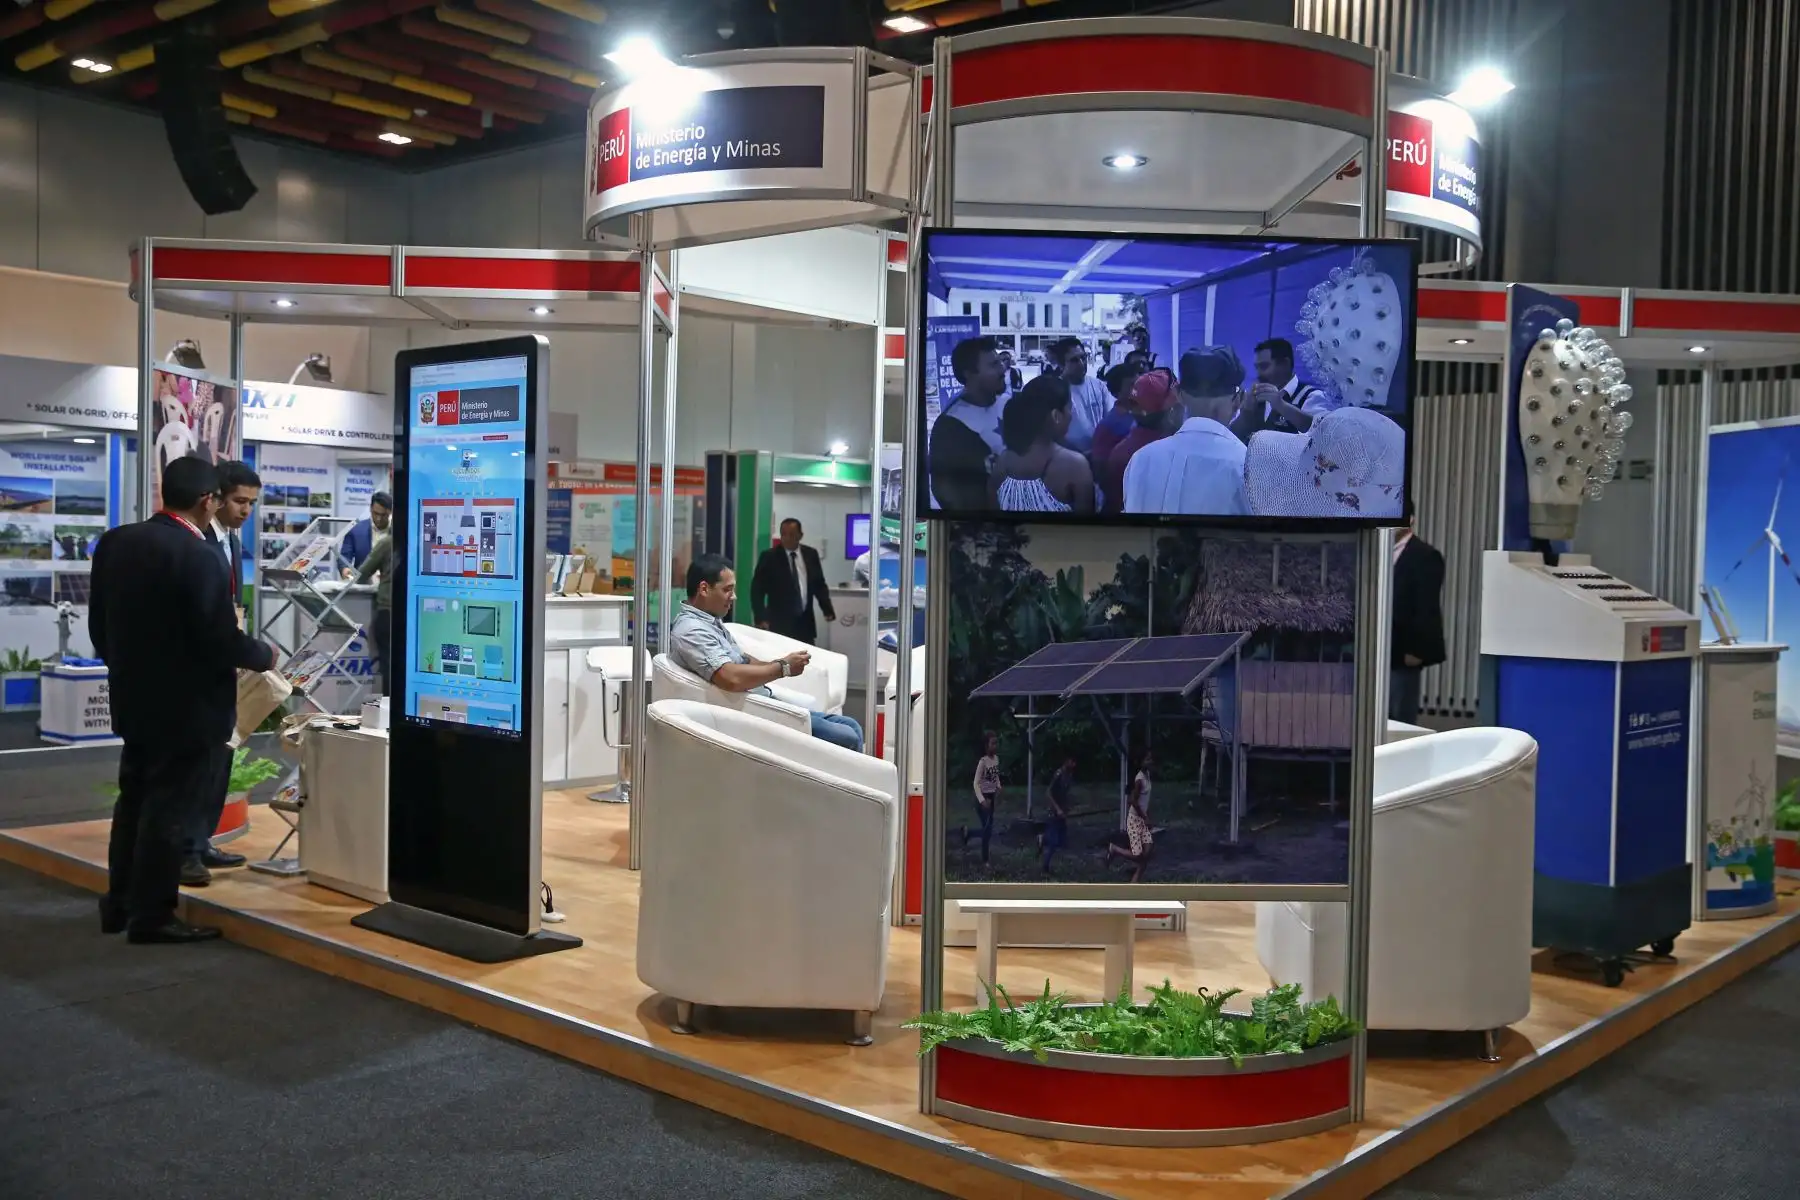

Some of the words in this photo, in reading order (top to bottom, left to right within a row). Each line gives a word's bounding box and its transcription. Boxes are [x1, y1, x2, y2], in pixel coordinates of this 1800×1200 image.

[636, 122, 706, 150] Ministerio
[599, 129, 625, 165] PERÚ
[635, 151, 650, 170] de
[653, 142, 707, 166] Energía
[711, 144, 722, 163] y
[726, 140, 781, 158] Minas
[1438, 173, 1452, 193] de
[940, 378, 950, 388] DE
[34, 403, 66, 415] SOLAR
[439, 401, 457, 413] PERÚ
[461, 400, 488, 410] Ministerio
[461, 412, 469, 420] de
[469, 411, 489, 421] Energía
[489, 412, 493, 420] y
[493, 410, 510, 418] Minas
[287, 426, 312, 436] SOLAR
[314, 428, 336, 437] DRIVE
[10, 451, 66, 462] WORLDWIDE
[69, 455, 98, 464] SOLAR
[23, 462, 85, 472] INSTALLATION
[84, 718, 110, 728] WITH
